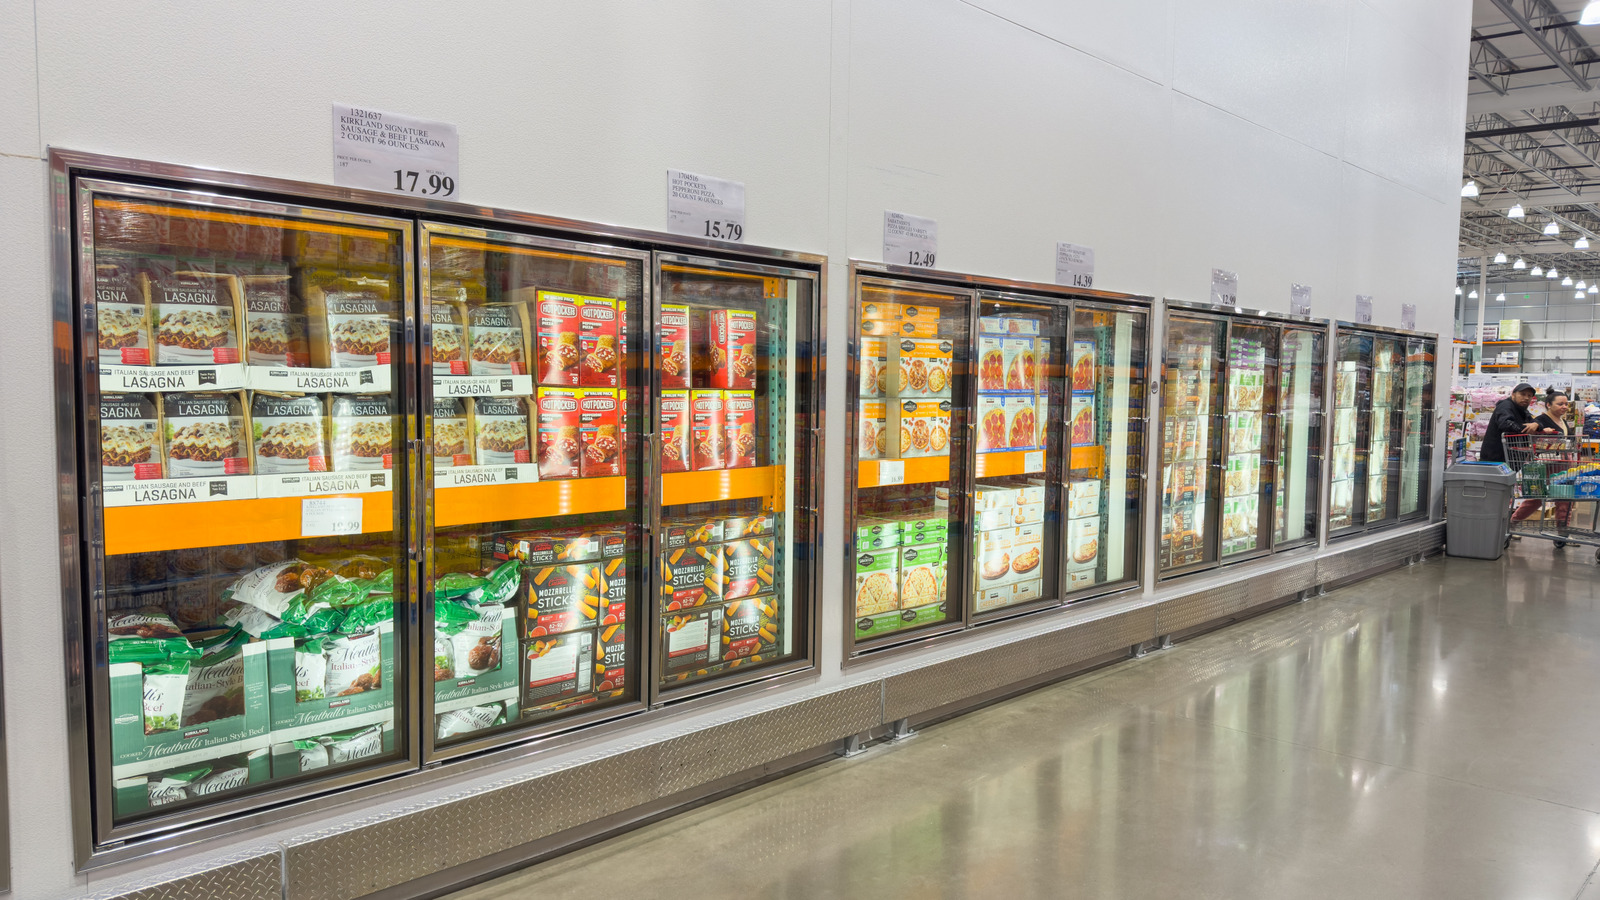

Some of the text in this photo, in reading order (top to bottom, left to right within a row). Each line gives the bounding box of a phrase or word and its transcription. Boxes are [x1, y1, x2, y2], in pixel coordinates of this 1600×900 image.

[350, 108, 382, 122] 1321637
[340, 116, 429, 138] KIRKLAND SIGNATURE
[340, 125, 446, 149] SAUSAGE & BEEF LASAGNA
[341, 132, 346, 140] 2
[347, 134, 376, 145] COUNT
[388, 141, 420, 152] OUNCES
[394, 170, 455, 196] 17.99
[678, 172, 699, 182] 1704516
[684, 180, 707, 190] POCKETS
[672, 186, 715, 198] PEPPERONI PIZZA
[679, 193, 697, 201] COUNT
[704, 198, 724, 206] OUNCES
[704, 220, 743, 240] 15.79
[908, 251, 935, 268] 12.49
[1073, 274, 1093, 288] 14.39
[97, 291, 128, 302] AGNA
[164, 292, 218, 304] LASAGNA
[334, 303, 378, 314] LASAGNA
[542, 304, 576, 316] HOT POCKETS
[583, 308, 614, 319] HOT POCKETS
[432, 314, 452, 323] AGNA
[476, 318, 512, 326] LASAGNA
[122, 376, 186, 388] LASAGNA
[297, 378, 350, 388] LASAGNA
[448, 384, 492, 394] LASAGNA
[178, 405, 230, 416] LASAGNA
[267, 406, 313, 416] LASAGNA
[350, 406, 388, 415] ASAGNA
[483, 406, 519, 414] LASAGNA
[542, 400, 576, 410] HOT POCKETS
[583, 400, 614, 410] HOT POCKETS
[101, 408, 142, 418] SAGNA
[434, 408, 456, 418] AGNA
[454, 474, 497, 485] LASAGNA
[308, 480, 360, 492] LASAGNA
[134, 488, 197, 502] LASAGNA
[730, 556, 758, 566] MOZZARELLA
[674, 564, 704, 576] MOZZARELLA
[729, 564, 758, 576] STICKS
[672, 572, 705, 586] STICKS
[538, 586, 577, 597] MOZZARELLA
[538, 594, 578, 608] STICKS
[730, 623, 760, 637] STICKS
[606, 644, 624, 653] MOZZA
[604, 652, 625, 664] STIC
[191, 665, 244, 682] Meatba
[435, 680, 515, 702] eatballs Italian Style Beef
[290, 708, 346, 726] Meatballs
[346, 704, 367, 714] Italian
[368, 702, 384, 712] Style
[185, 728, 209, 736] KIRKLAND
[136, 738, 204, 760] Meatballs
[204, 736, 228, 746] Italian
[230, 732, 248, 742] Style
[248, 726, 265, 736] Beef
[194, 776, 249, 795] Meatba
